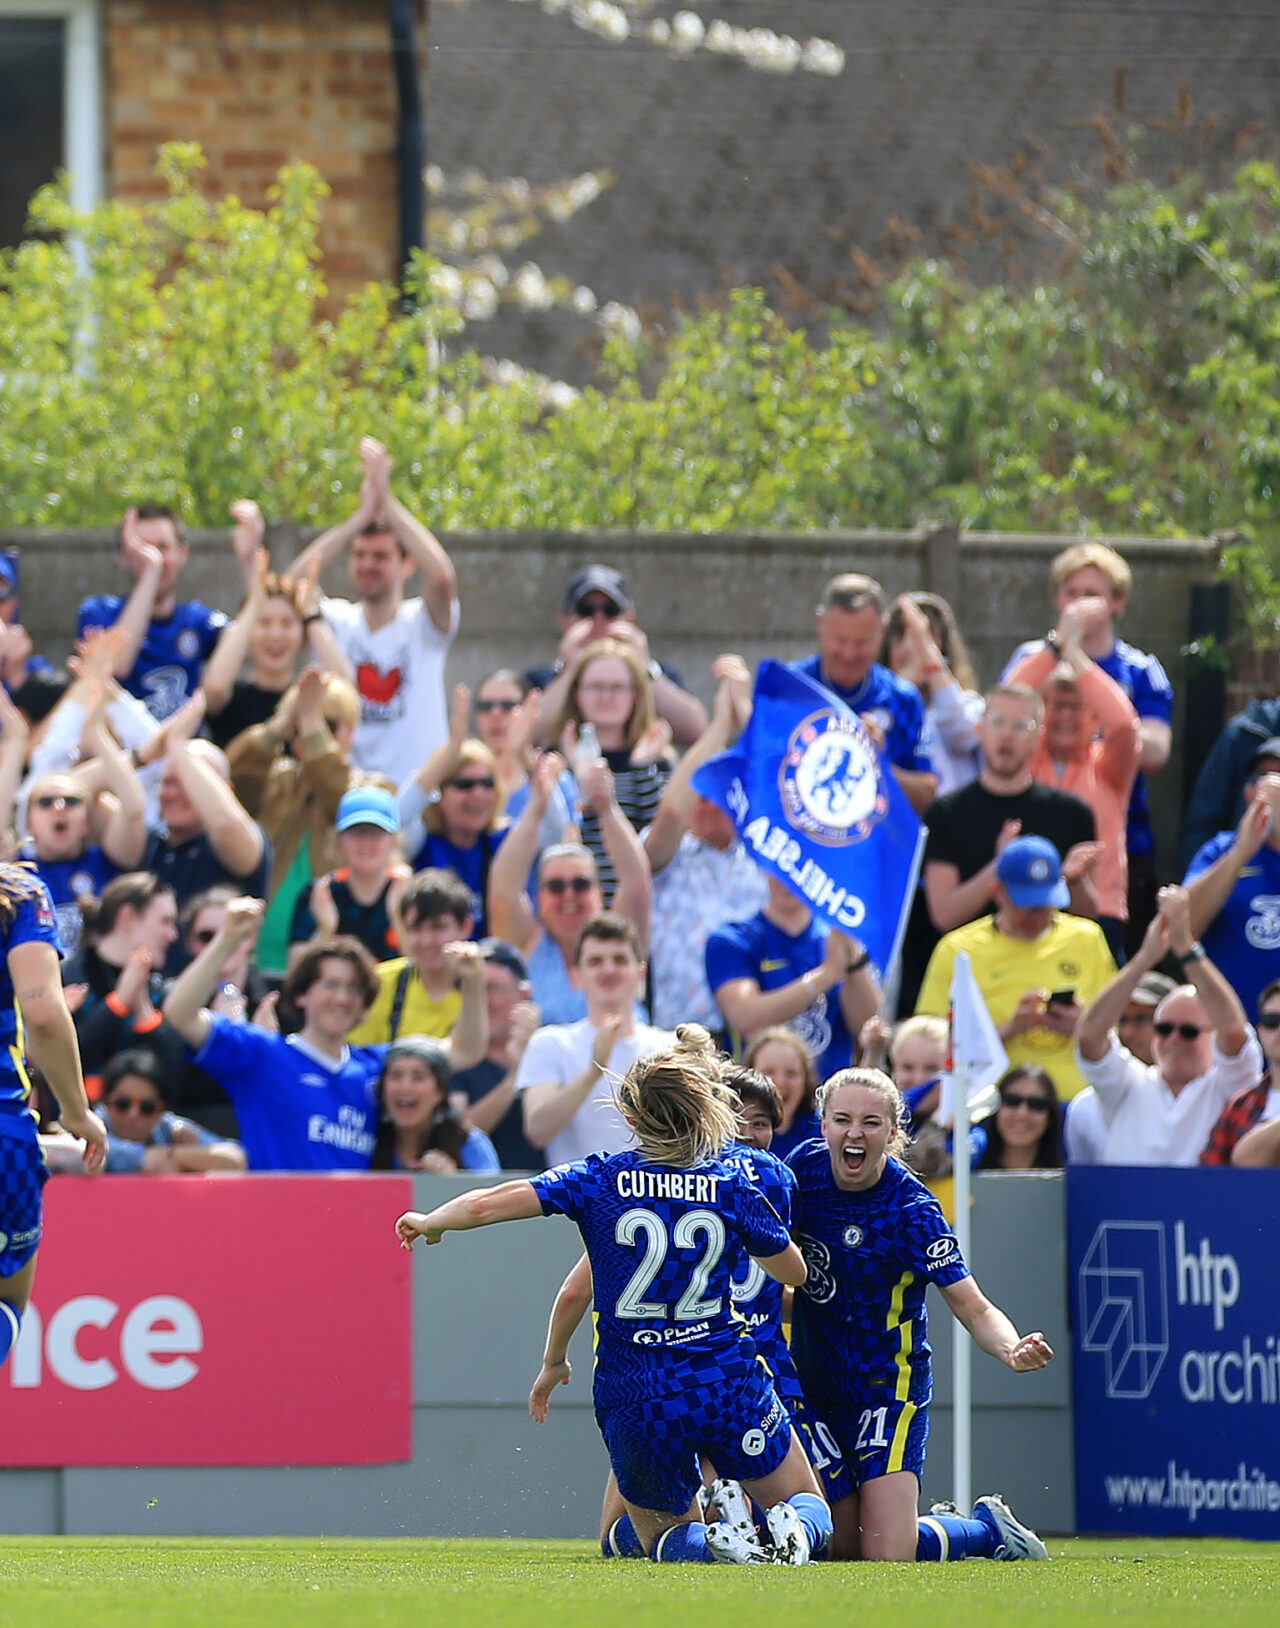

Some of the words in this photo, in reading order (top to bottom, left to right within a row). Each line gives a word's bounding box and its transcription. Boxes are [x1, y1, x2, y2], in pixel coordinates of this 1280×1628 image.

[617, 1170, 718, 1203] CUTHBERT
[614, 1207, 726, 1321] 22
[1175, 1219, 1240, 1331] htp
[663, 1321, 710, 1341] PLAN
[811, 1421, 842, 1470] 10
[855, 1406, 889, 1450] 21
